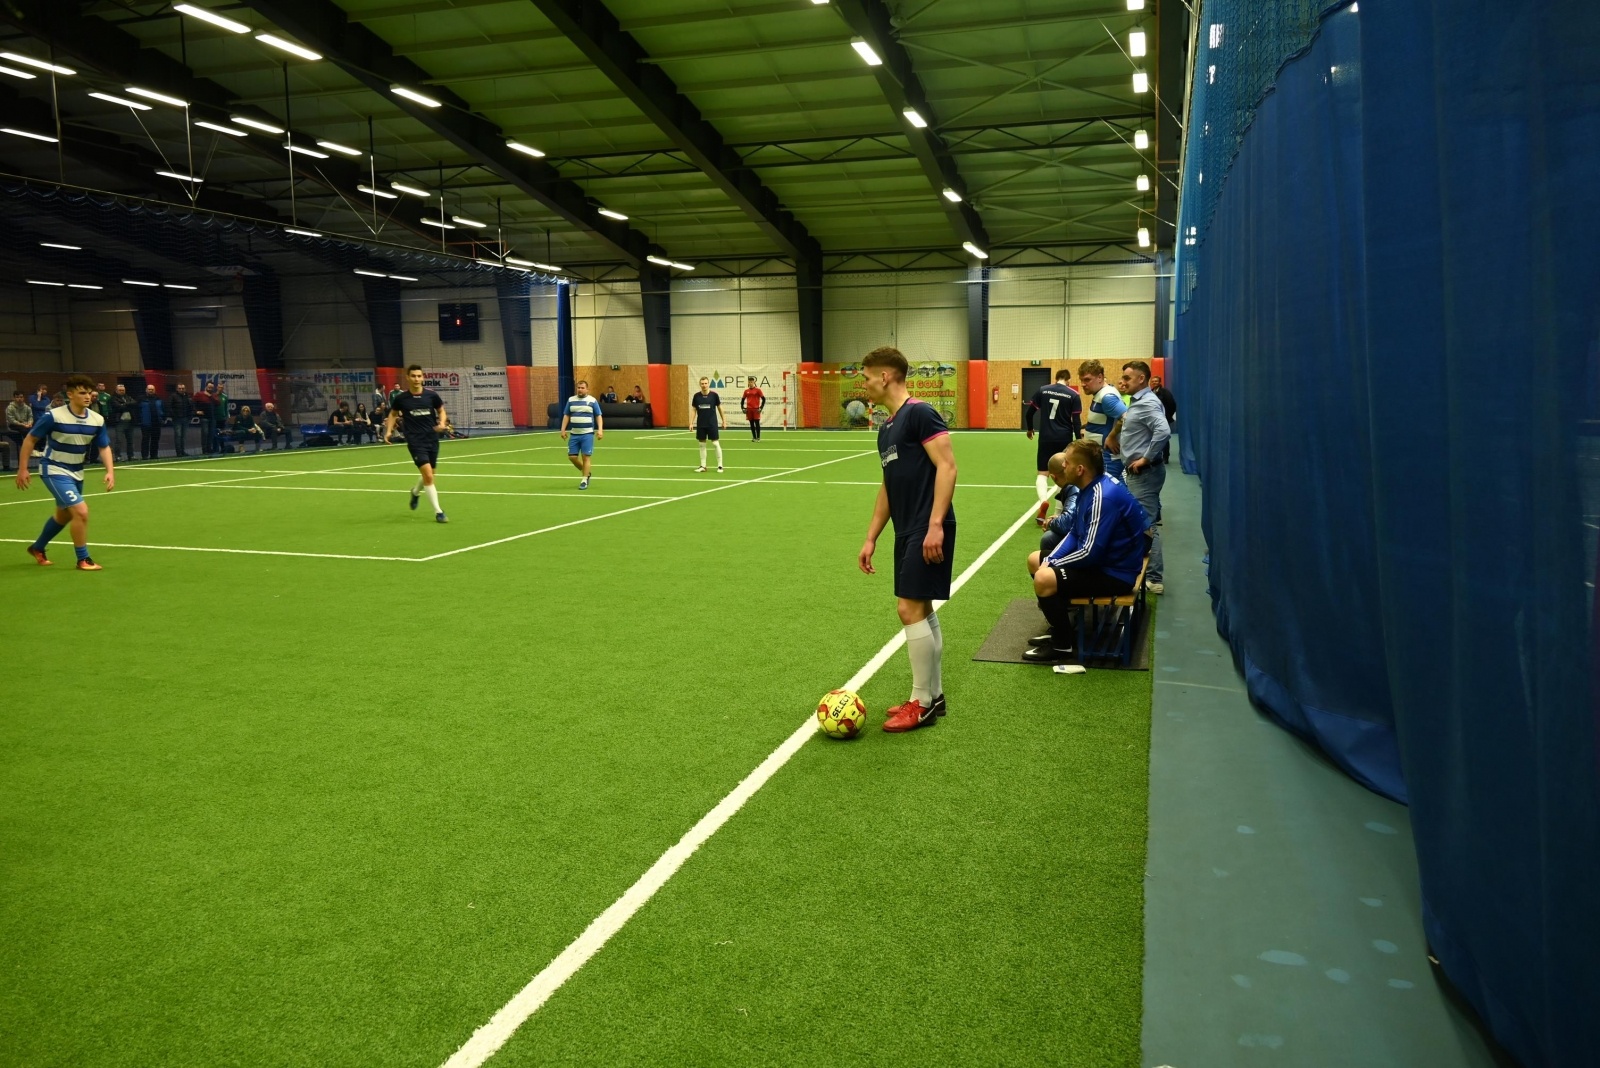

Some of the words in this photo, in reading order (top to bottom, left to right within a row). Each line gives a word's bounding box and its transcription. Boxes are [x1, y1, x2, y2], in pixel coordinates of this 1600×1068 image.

[917, 380, 943, 388] GOLF
[915, 389, 955, 397] BOHUMÍN
[1049, 398, 1060, 420] 7
[65, 490, 78, 502] 3
[832, 694, 851, 718] SELECT
